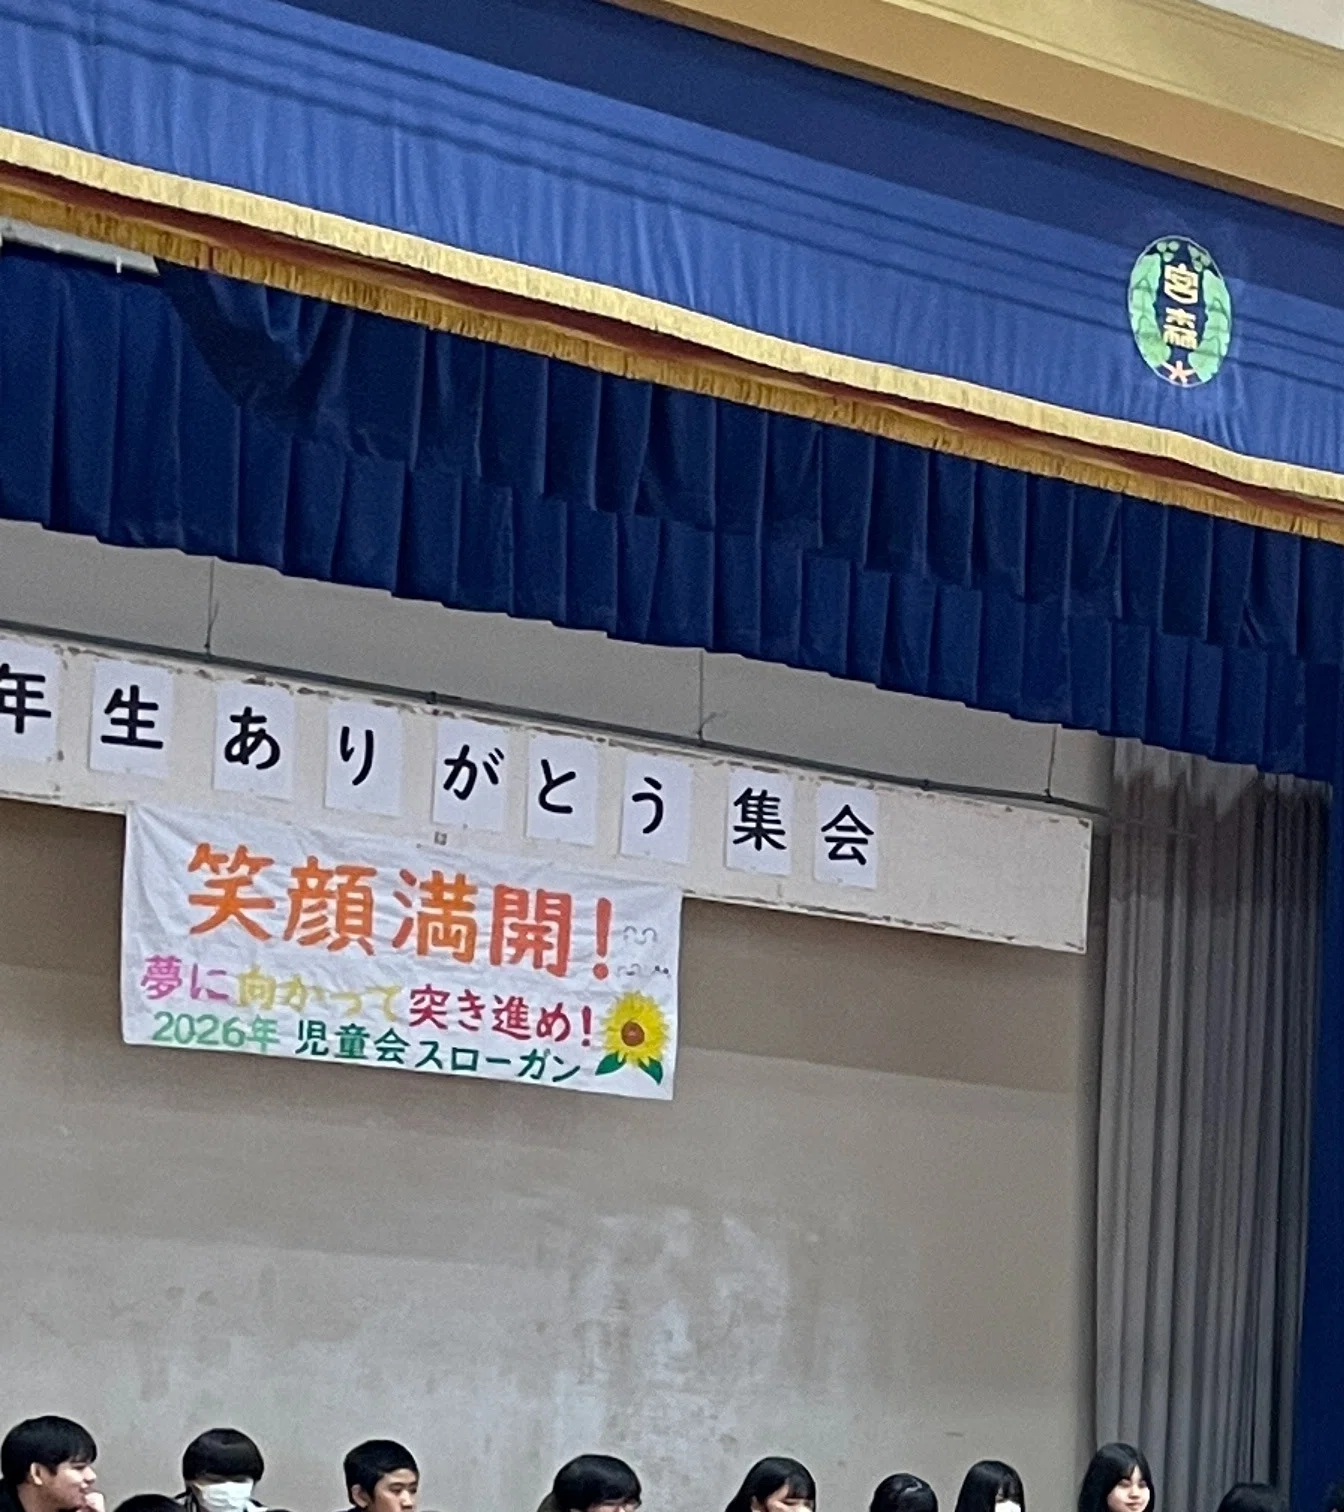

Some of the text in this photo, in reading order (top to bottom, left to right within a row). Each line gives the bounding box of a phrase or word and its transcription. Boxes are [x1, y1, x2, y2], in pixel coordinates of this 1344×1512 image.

[152, 1010, 582, 1083] 2026年 児童会スローガン
